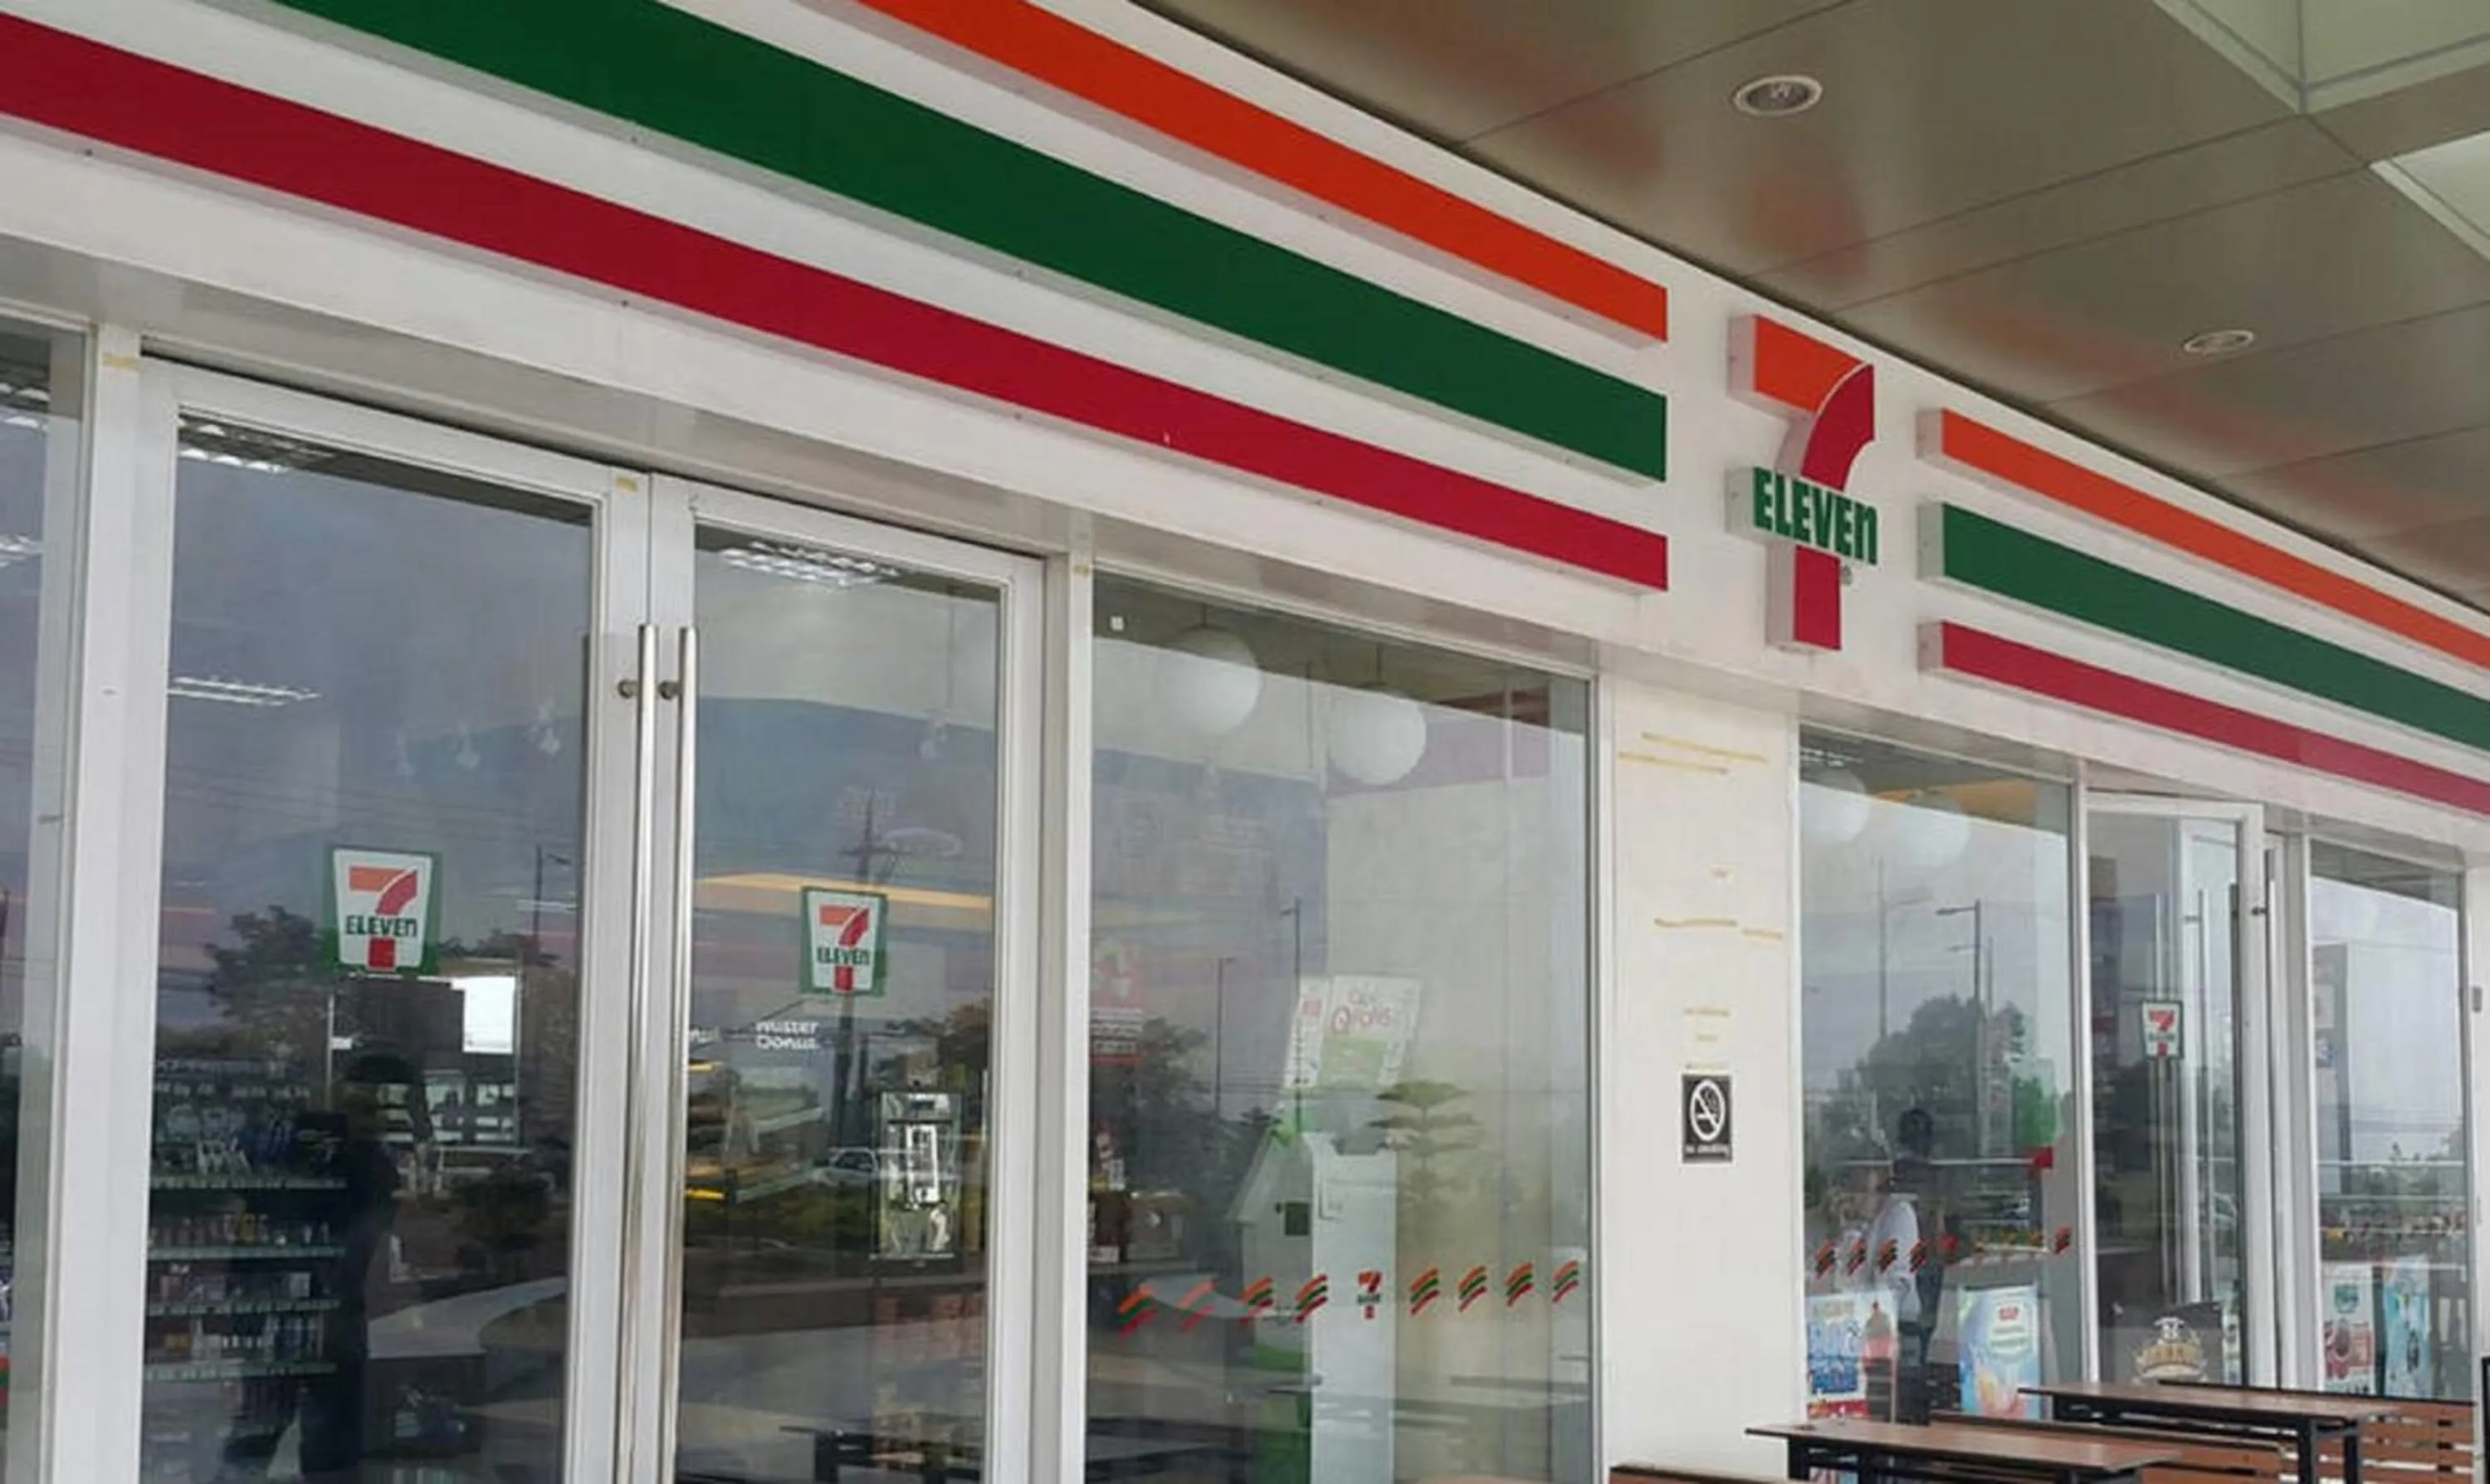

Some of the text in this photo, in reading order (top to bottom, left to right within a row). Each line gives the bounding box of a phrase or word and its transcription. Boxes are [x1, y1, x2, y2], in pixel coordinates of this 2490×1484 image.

[1754, 314, 1876, 651] 7
[349, 866, 418, 969] 7
[819, 904, 870, 991] 7
